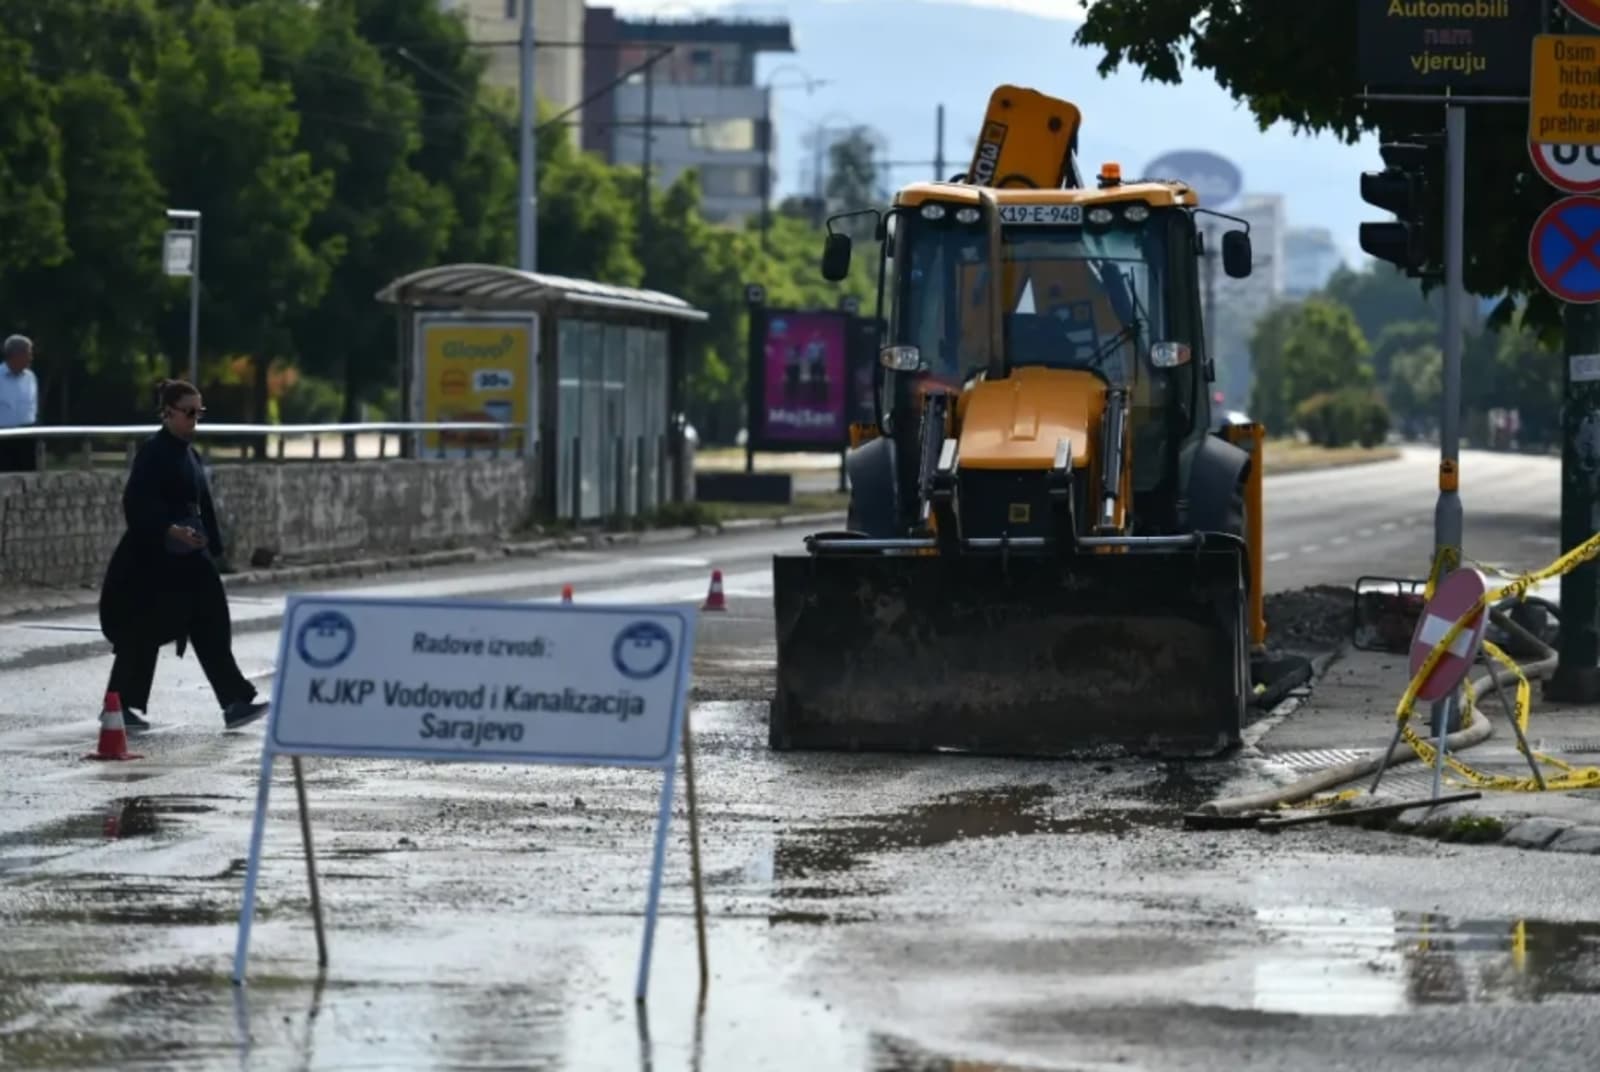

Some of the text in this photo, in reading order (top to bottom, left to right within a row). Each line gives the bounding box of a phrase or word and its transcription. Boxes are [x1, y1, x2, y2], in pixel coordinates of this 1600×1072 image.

[1387, 0, 1509, 17] Automobili
[1554, 40, 1595, 61] Osim
[1410, 51, 1486, 75] vjeruju
[412, 632, 484, 656] Radove
[308, 677, 645, 723] KJKP Vodovod i Kanalizacija
[419, 711, 525, 748] Sarajevo
